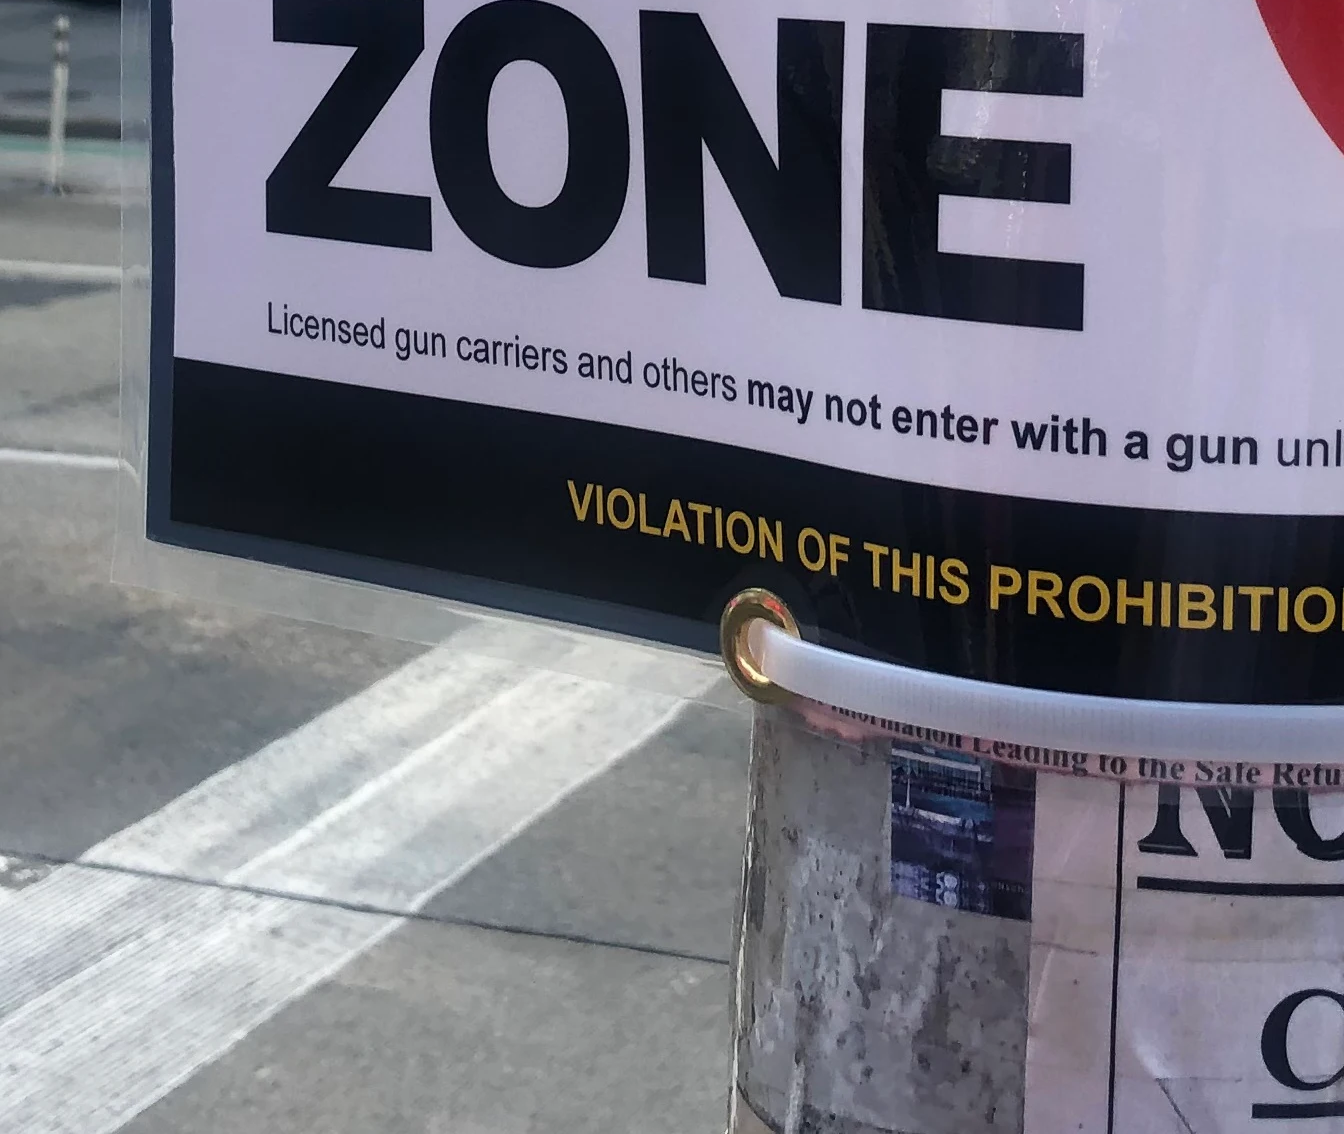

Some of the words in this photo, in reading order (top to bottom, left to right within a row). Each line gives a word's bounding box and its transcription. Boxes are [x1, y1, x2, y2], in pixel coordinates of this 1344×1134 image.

[268, 302, 386, 350] Licensed
[396, 328, 447, 362] gun
[457, 335, 568, 375] carriers
[578, 351, 633, 385] and
[644, 357, 737, 402] others
[748, 378, 814, 425] may
[826, 394, 882, 430] not
[893, 404, 999, 446] enter
[1011, 413, 1107, 457] with
[1124, 430, 1149, 460] a
[1167, 433, 1258, 473] gun
[567, 479, 783, 563] VIOLATION
[798, 527, 850, 577] OF
[863, 541, 970, 606] THIS
[972, 735, 1089, 777] Leading
[1098, 754, 1129, 776] to
[1138, 756, 1186, 781] the
[1194, 759, 1262, 784] Safe
